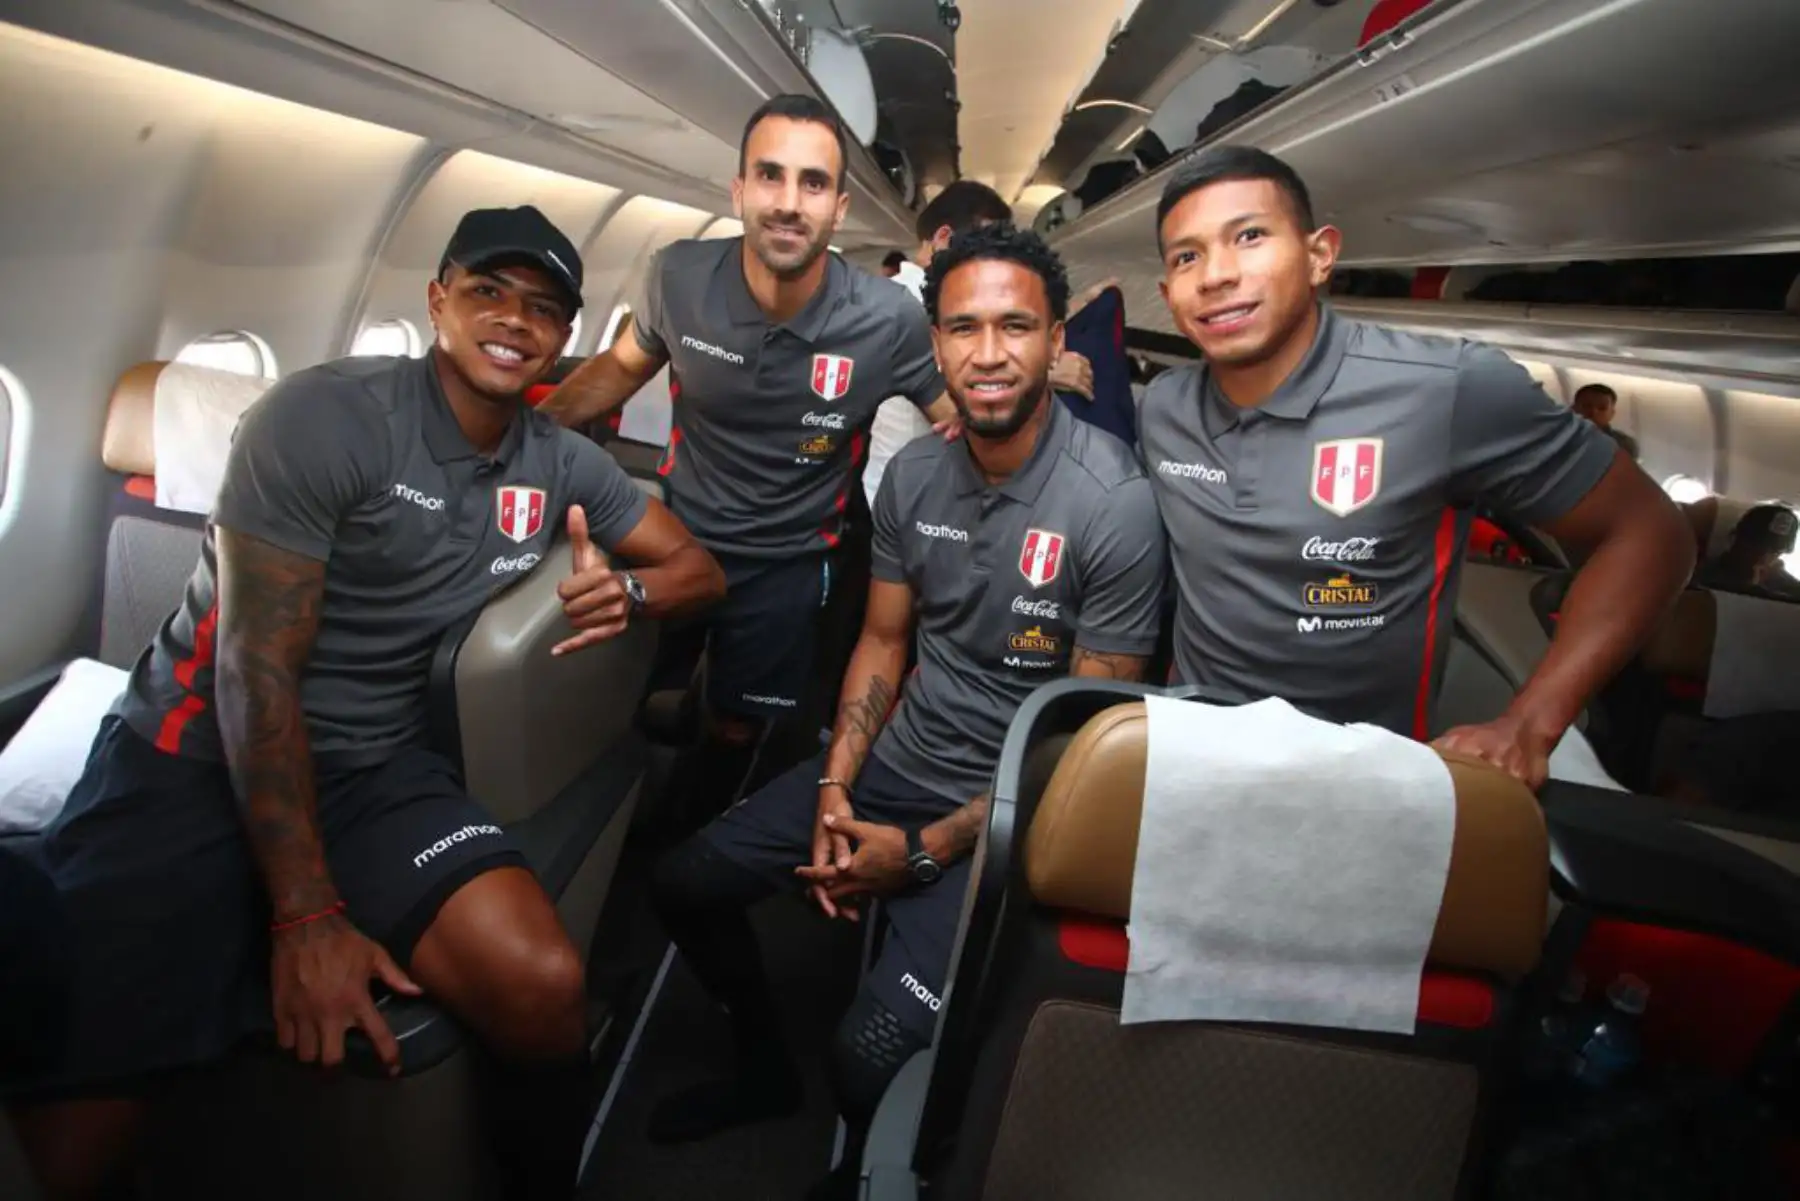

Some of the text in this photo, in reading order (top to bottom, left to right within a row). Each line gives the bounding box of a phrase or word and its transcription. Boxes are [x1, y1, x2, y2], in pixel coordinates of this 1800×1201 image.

[681, 335, 744, 364] marathon
[1158, 461, 1228, 484] marathon
[1302, 536, 1380, 560] Coca-Cola
[1011, 594, 1061, 620] Coca-Cola
[1307, 587, 1374, 605] CRISTAL
[1324, 614, 1385, 630] movistar
[413, 824, 503, 868] marathon
